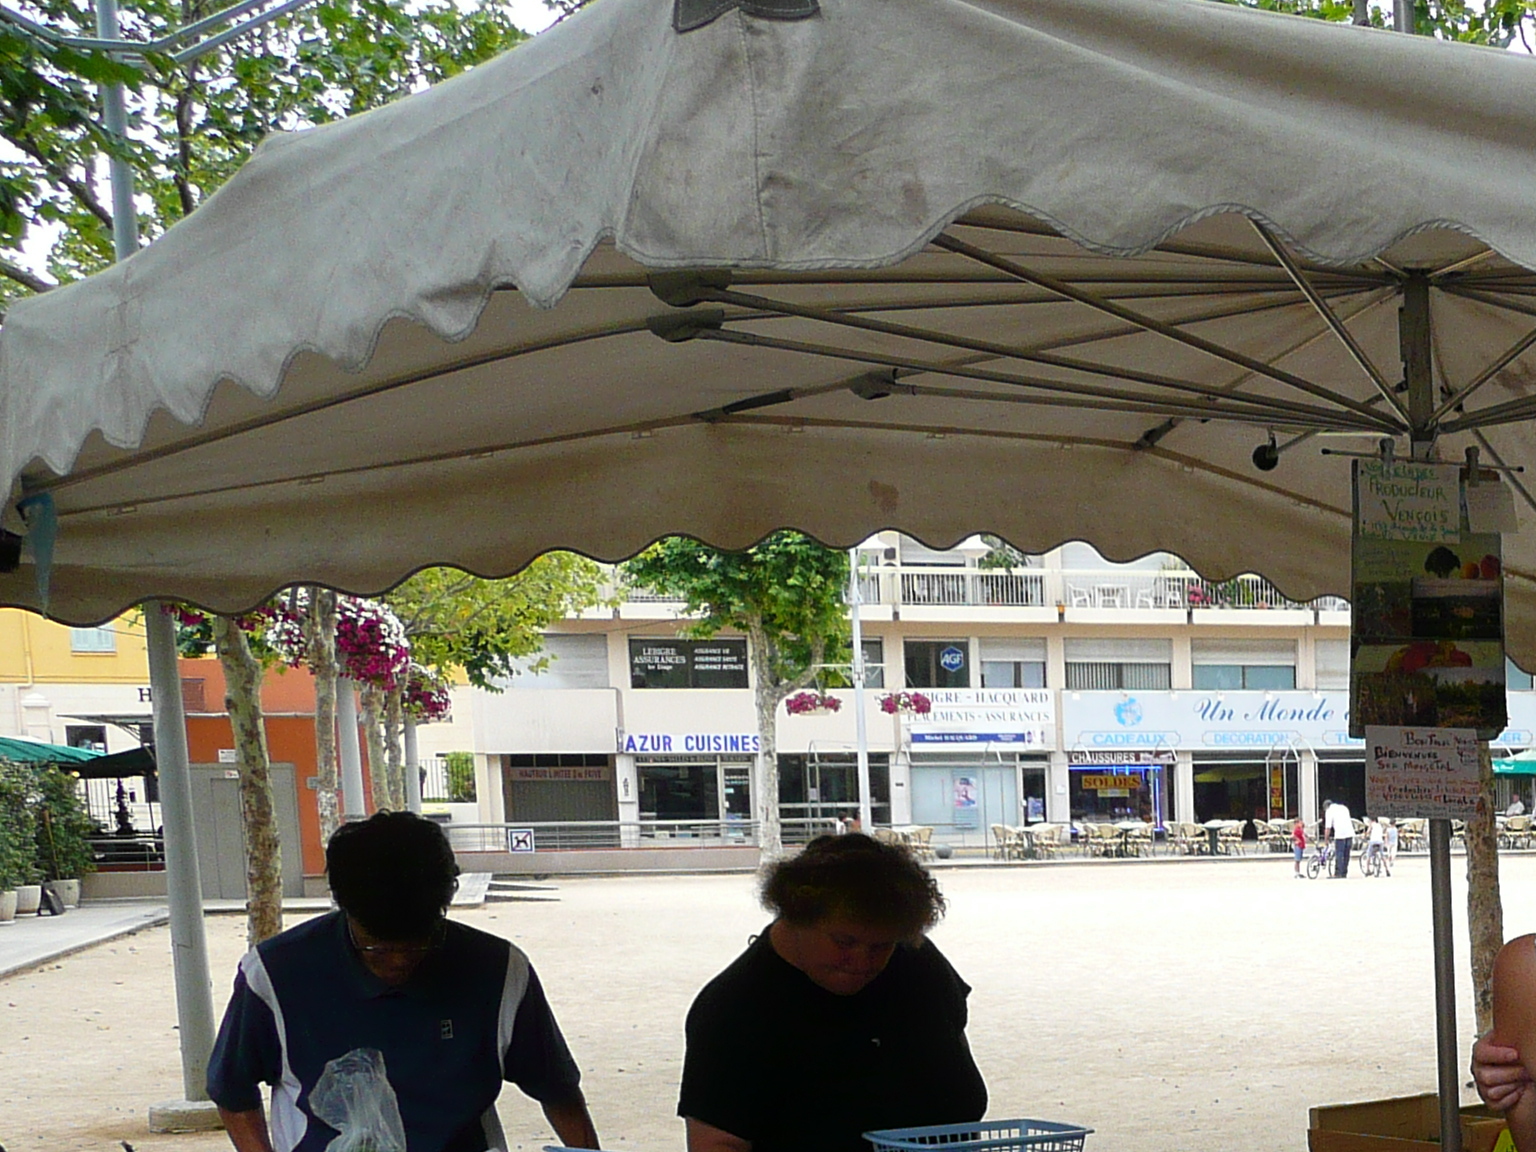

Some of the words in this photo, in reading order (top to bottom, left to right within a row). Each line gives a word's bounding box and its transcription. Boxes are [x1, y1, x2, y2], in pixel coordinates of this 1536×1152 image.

[633, 655, 687, 665] ASSURANCES
[941, 653, 963, 665] AGF
[975, 692, 1049, 706] HACQUARD
[1193, 698, 1235, 722] Un
[1243, 698, 1335, 722] Monde
[985, 711, 1050, 722] ASSURANCES
[625, 734, 673, 752] AZUR
[685, 734, 760, 752] CUISINES
[1092, 734, 1167, 746] CADEAUX
[1214, 733, 1289, 745] DECORATION
[1071, 752, 1137, 764] CHAUSSURES
[1083, 776, 1141, 789] SOLDES
